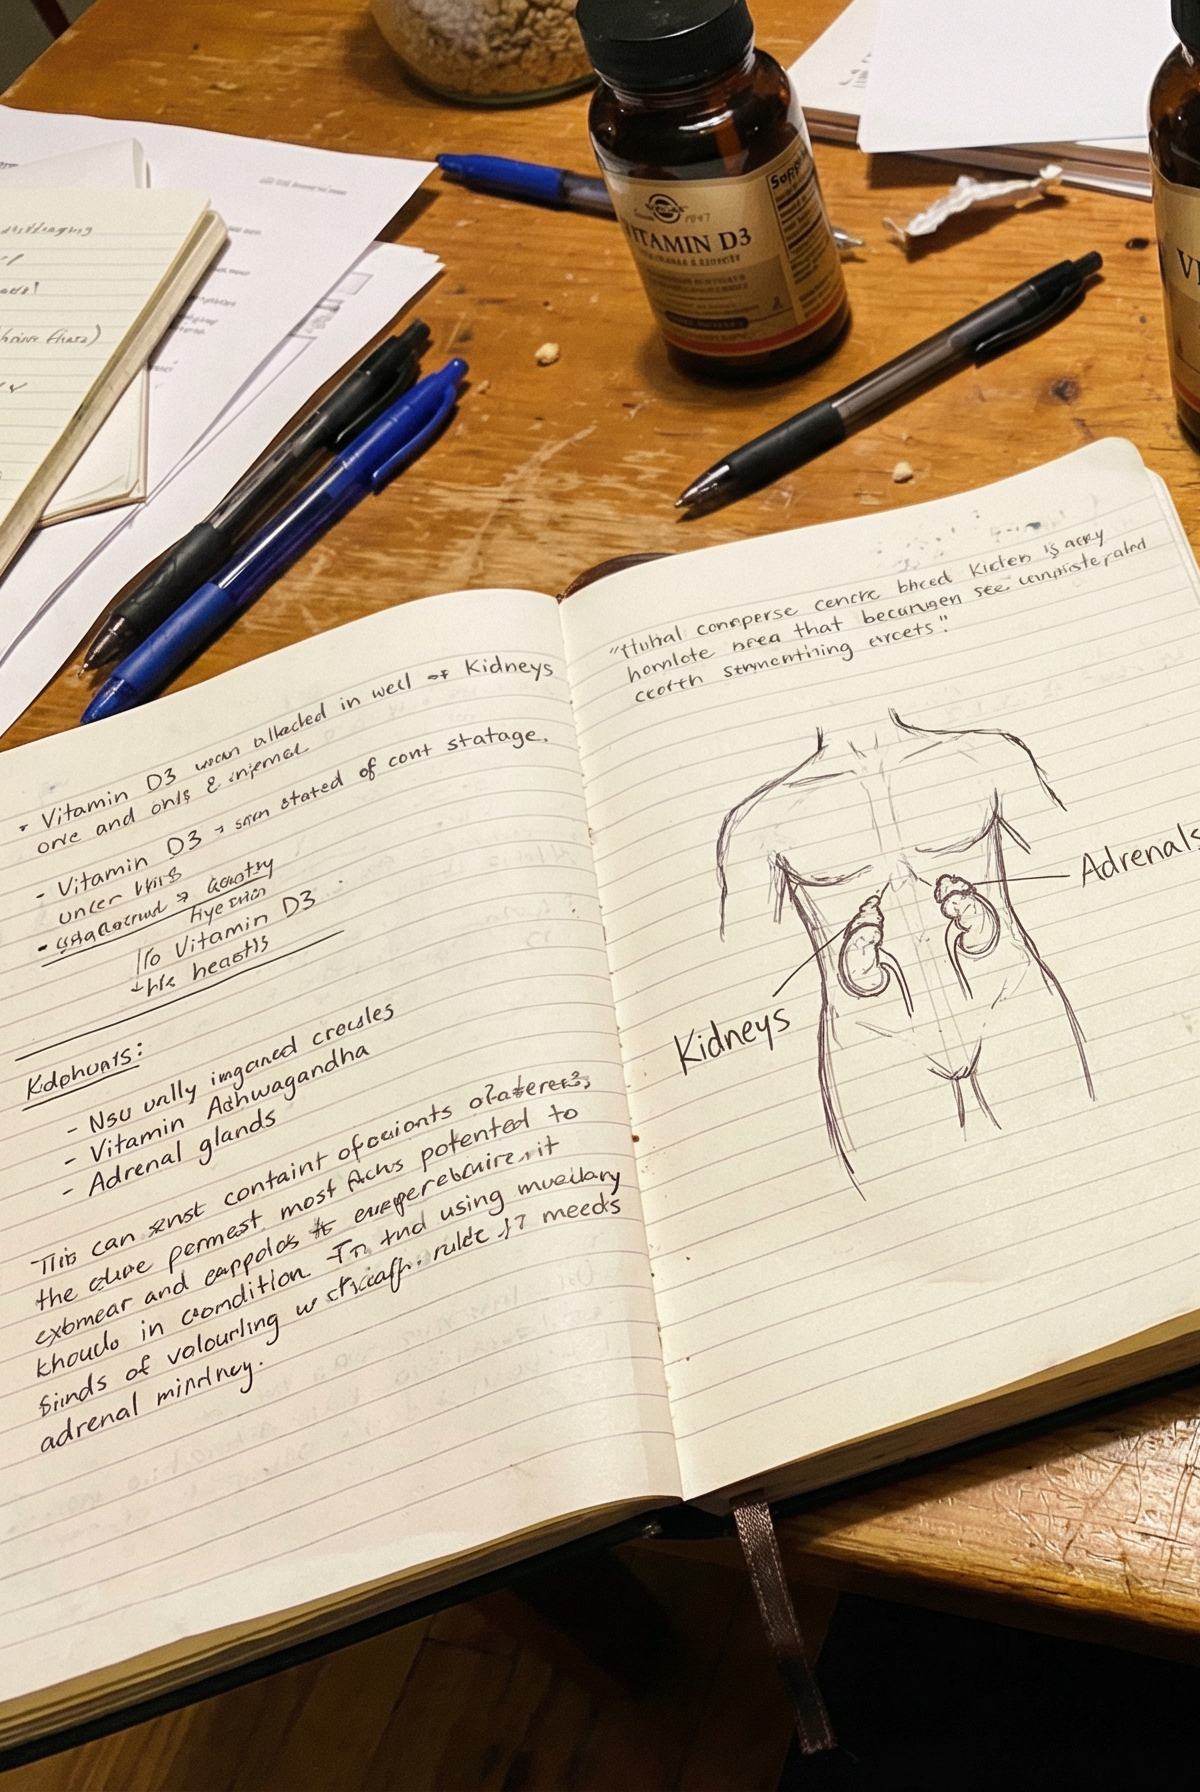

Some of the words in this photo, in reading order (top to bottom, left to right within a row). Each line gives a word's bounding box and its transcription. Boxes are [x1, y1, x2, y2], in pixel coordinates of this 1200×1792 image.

[718, 227, 751, 251] D3
[793, 615, 844, 639] that
[41, 789, 129, 830] Vitamin
[147, 767, 177, 792] D3
[340, 695, 361, 711] in
[465, 655, 555, 682] Kidneys
[57, 855, 149, 898] Vitamin
[166, 829, 203, 857] D3
[359, 756, 377, 781] of
[96, 806, 136, 837] and
[175, 913, 269, 959] Vitamin
[282, 889, 317, 919] D3
[673, 1006, 792, 1076] Kidneys
[88, 1140, 182, 1197] Adrenal
[199, 1107, 277, 1166] glands
[90, 1114, 185, 1164] Vitamin
[35, 1285, 79, 1312] the
[281, 1177, 337, 1222] most
[547, 1103, 579, 1122] to
[91, 1231, 136, 1258] can
[140, 1319, 165, 1342] in
[440, 1188, 505, 1222] using
[144, 1268, 190, 1306] and
[125, 1353, 151, 1382] of
[40, 1390, 140, 1453] adrenal
